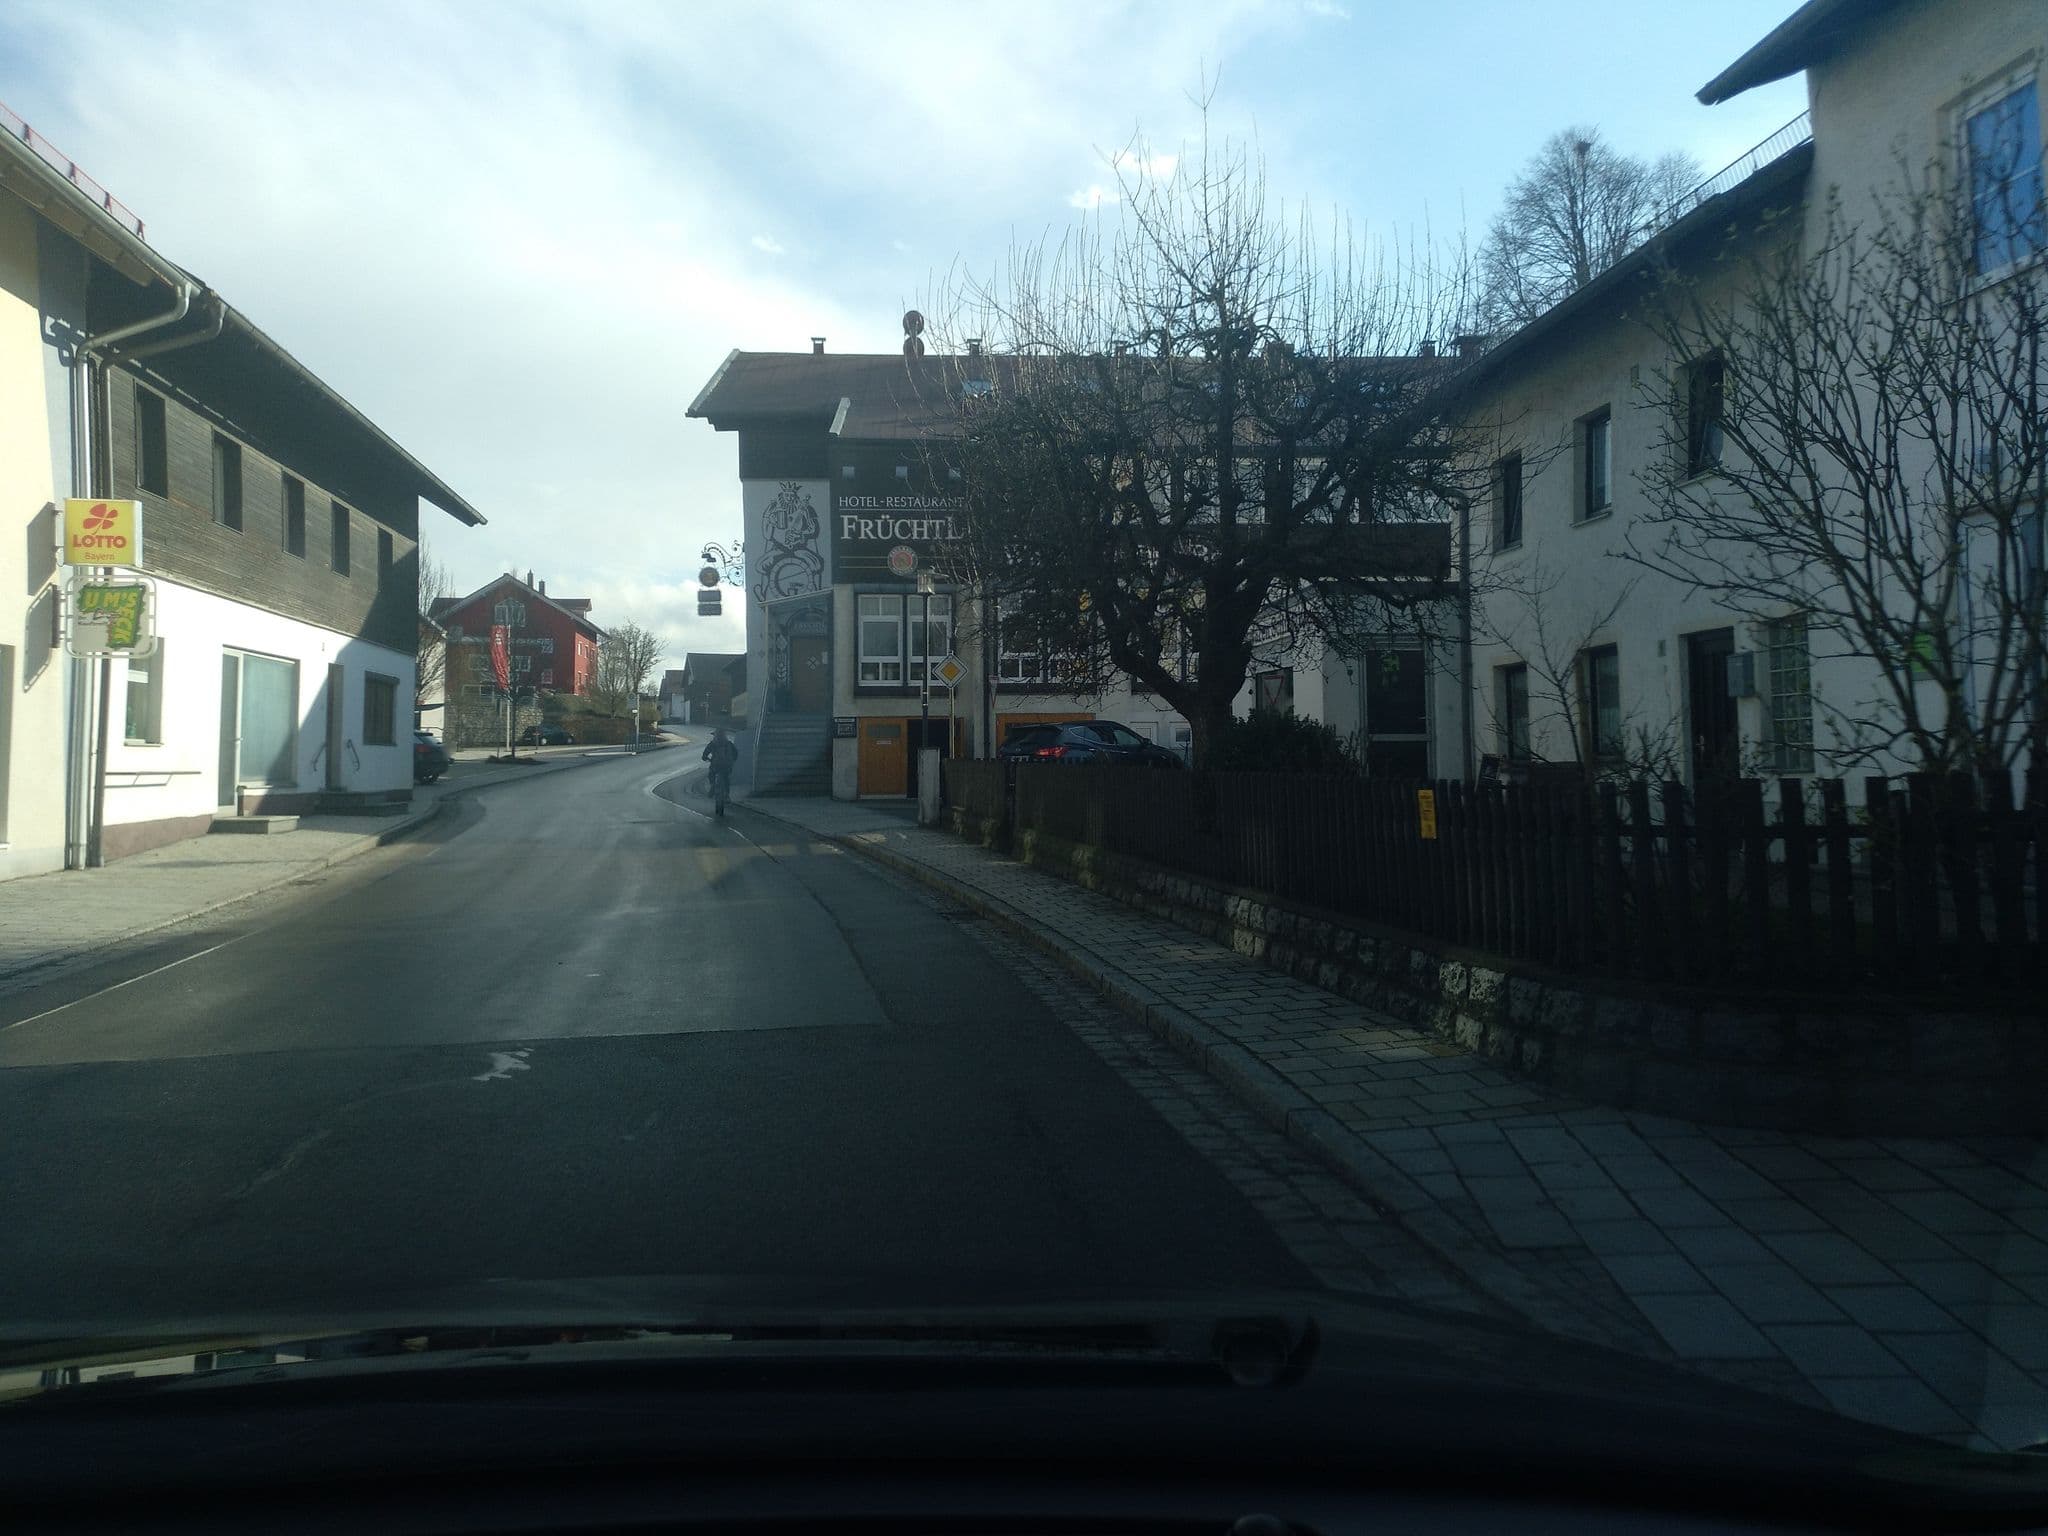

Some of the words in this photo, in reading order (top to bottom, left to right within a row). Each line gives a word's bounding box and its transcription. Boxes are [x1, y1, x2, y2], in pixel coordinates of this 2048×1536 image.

[839, 513, 964, 540] FRÜCHTL
[72, 535, 127, 548] LOTTO
[84, 552, 115, 562] Bayern
